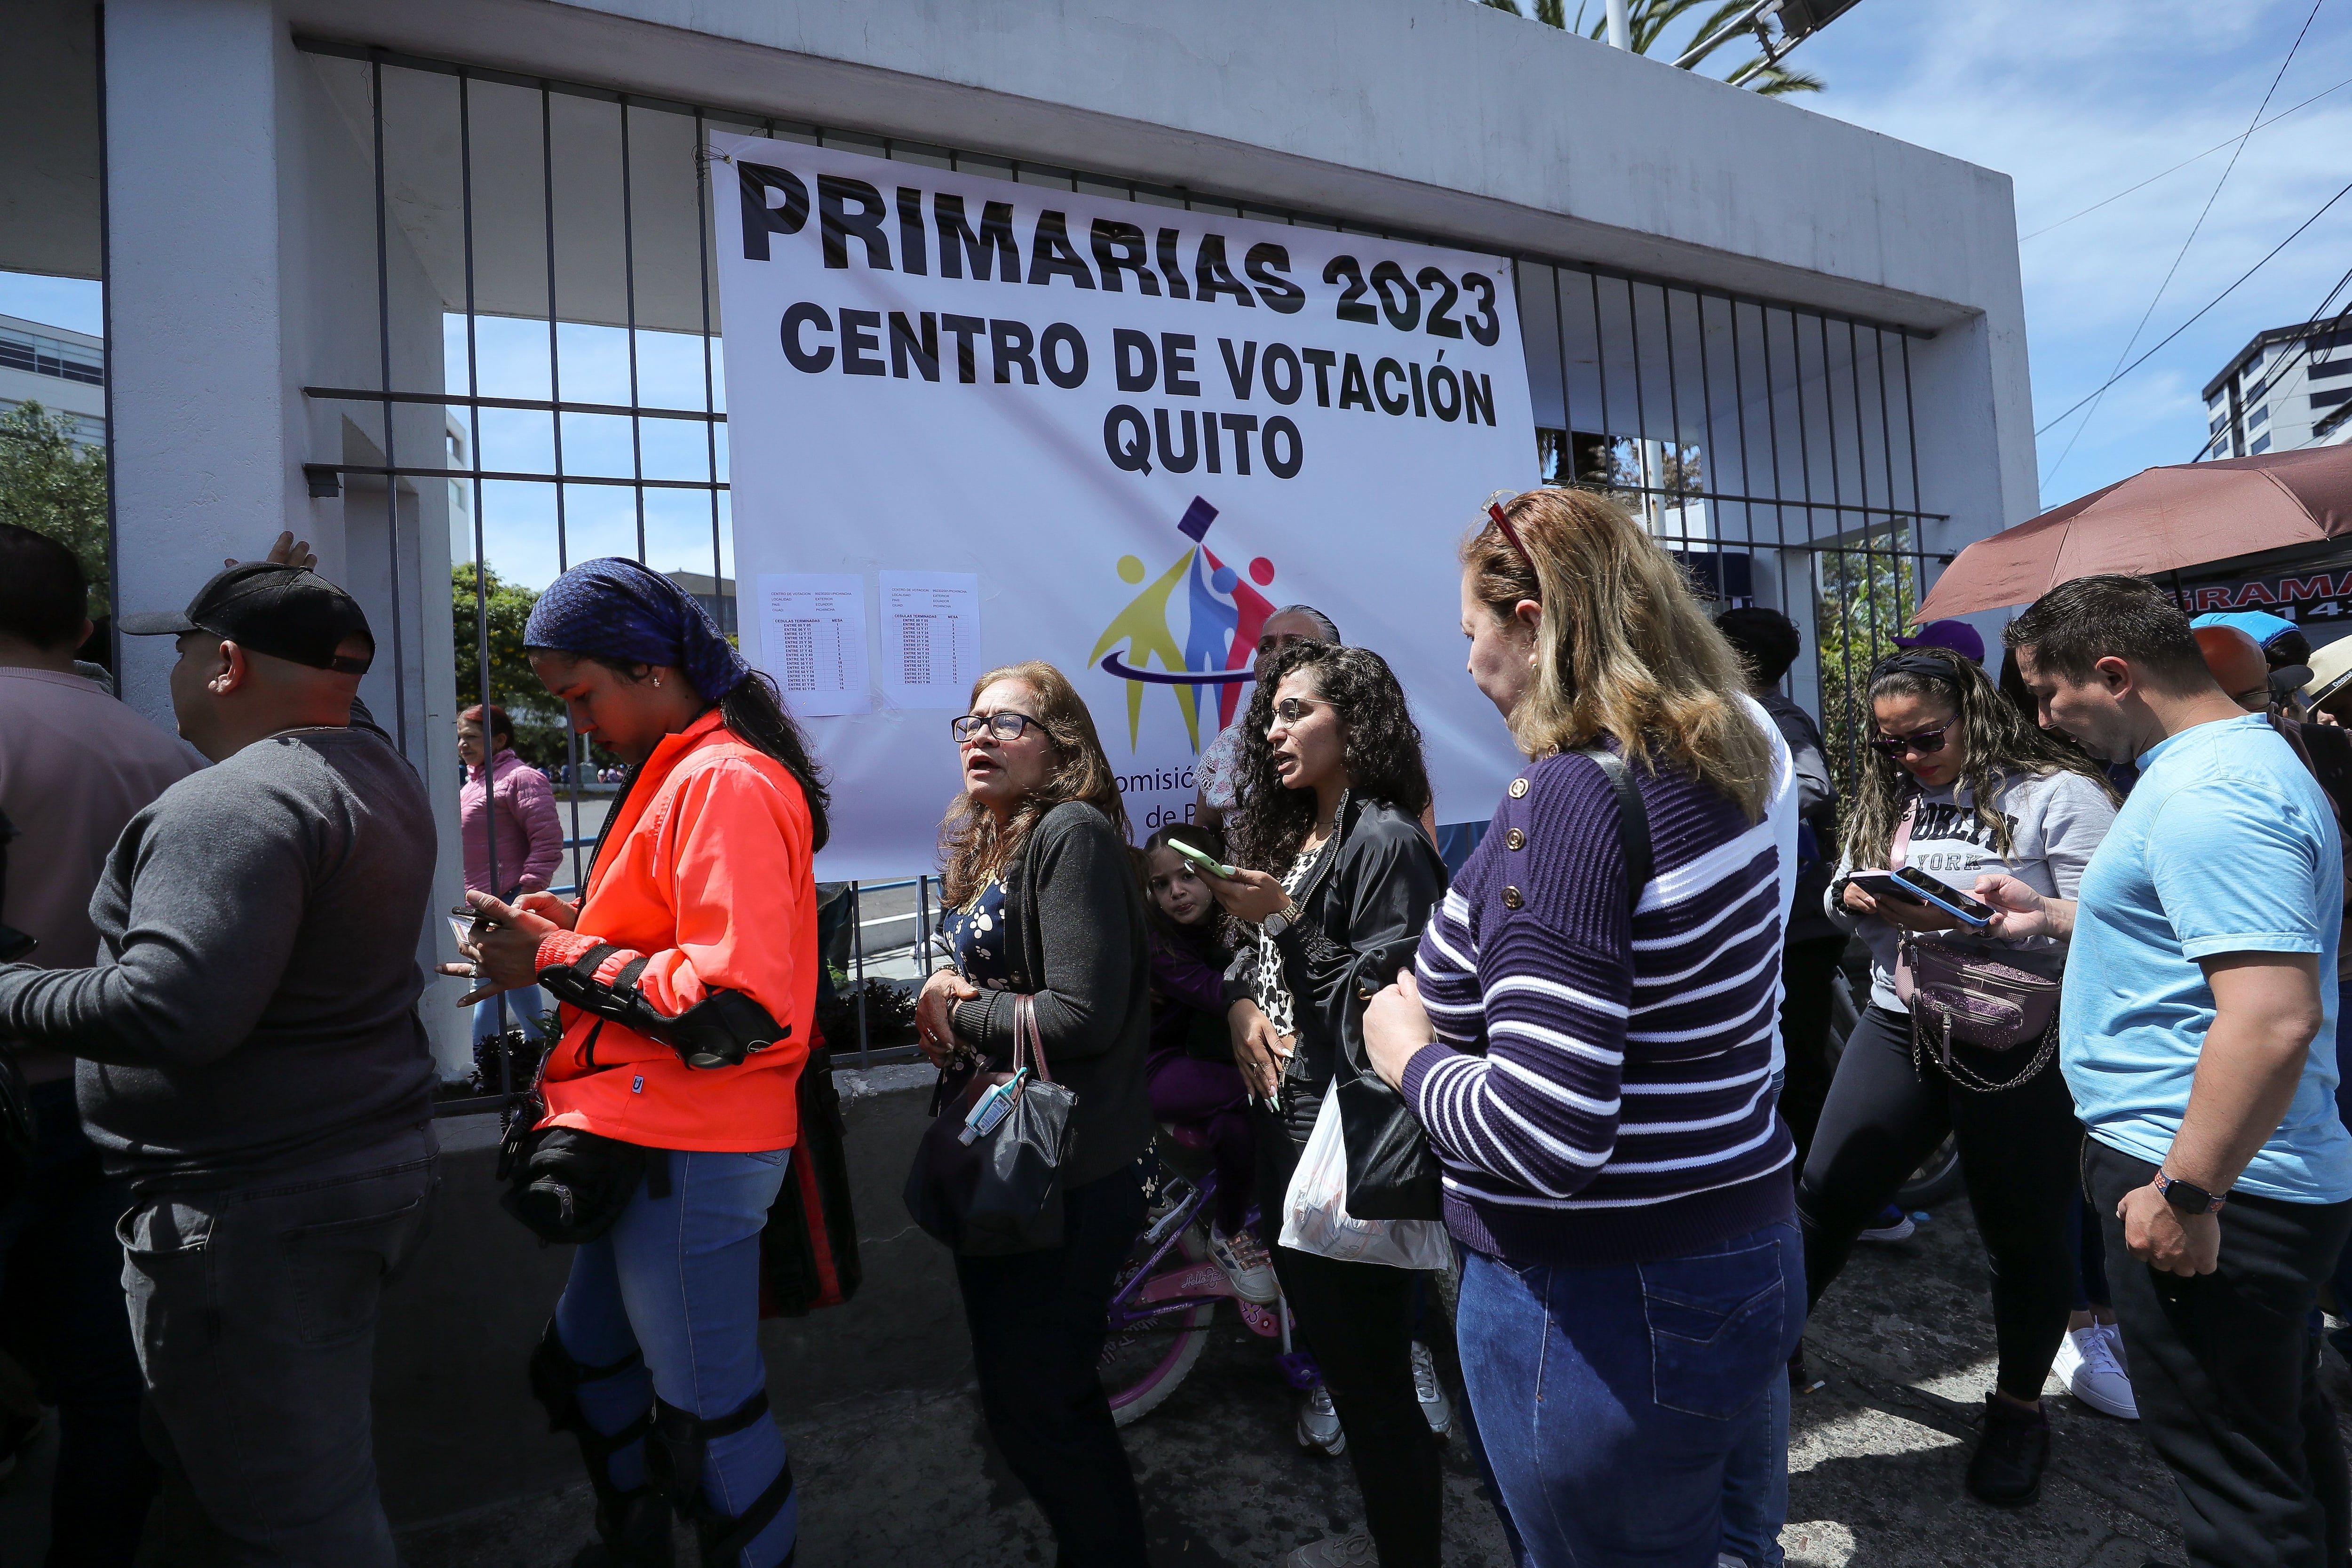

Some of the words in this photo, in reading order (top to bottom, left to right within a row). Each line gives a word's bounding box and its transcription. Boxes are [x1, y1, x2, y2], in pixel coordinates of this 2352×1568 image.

[737, 160, 1305, 314] PRIMARIAS
[1323, 255, 1500, 346] 2023
[781, 302, 1088, 389] CENTRO
[1113, 328, 1200, 397] DE
[1217, 338, 1496, 427] VOTACIÓN
[1104, 405, 1303, 479] QUITO
[1115, 765, 1194, 793] omisió
[1145, 804, 1176, 828] de
[1918, 853, 1984, 870] YORK
